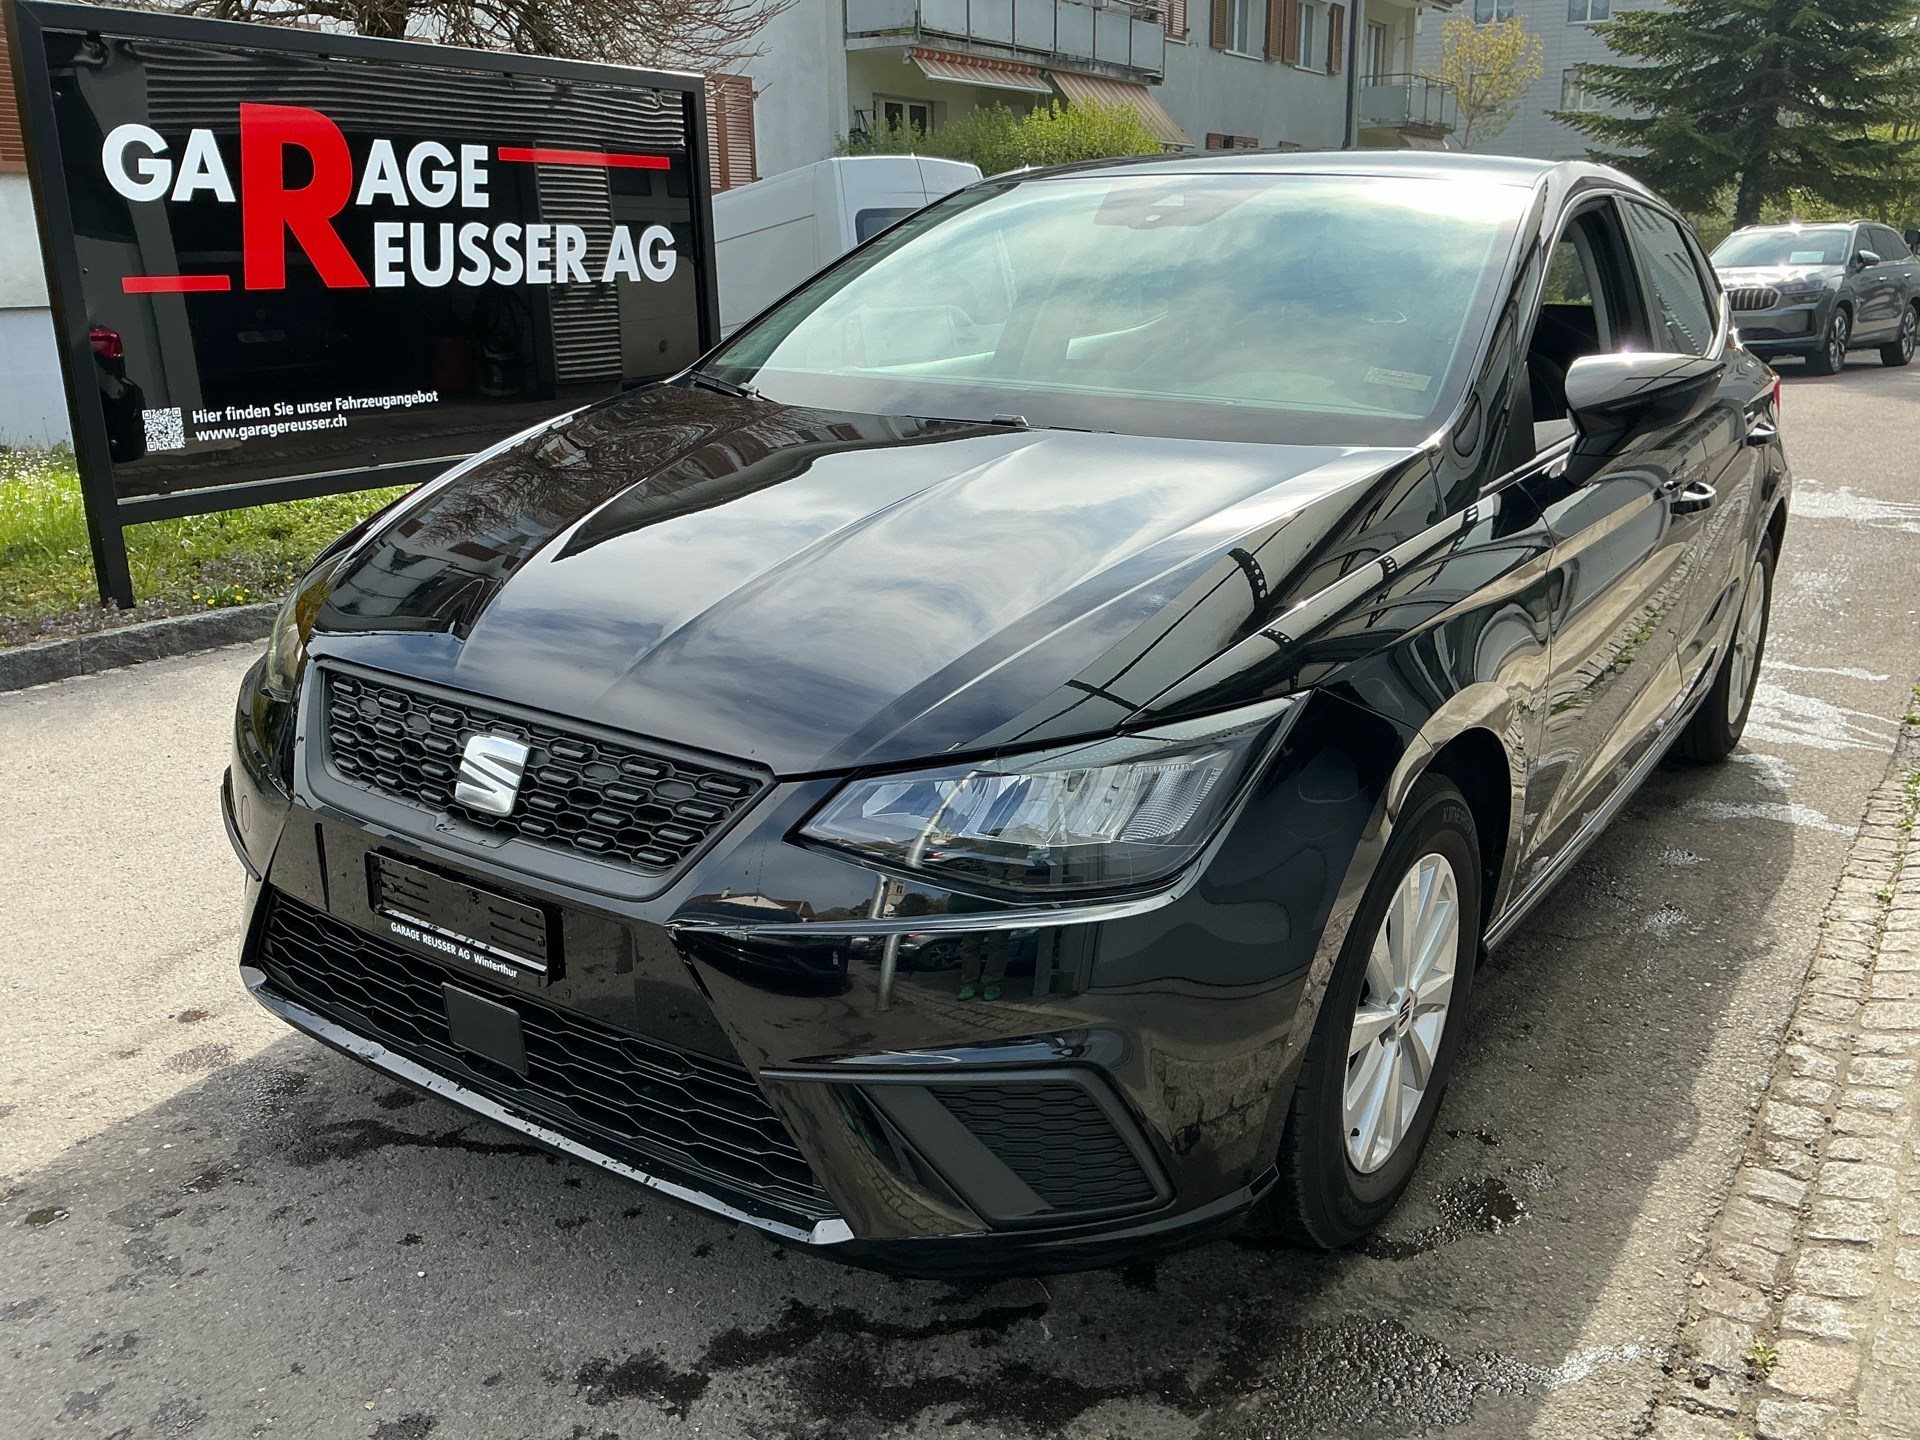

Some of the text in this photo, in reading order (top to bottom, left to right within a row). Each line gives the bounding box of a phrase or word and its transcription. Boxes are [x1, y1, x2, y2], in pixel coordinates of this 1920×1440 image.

[102, 103, 489, 290] GARAGE
[601, 224, 677, 283] AG
[192, 390, 439, 424] Hier finden Sie unser Fahrzeugangebot
[196, 414, 348, 442] www.garagereusser.ch
[391, 922, 517, 977] GARAGE REUSSER AG Winterthur
